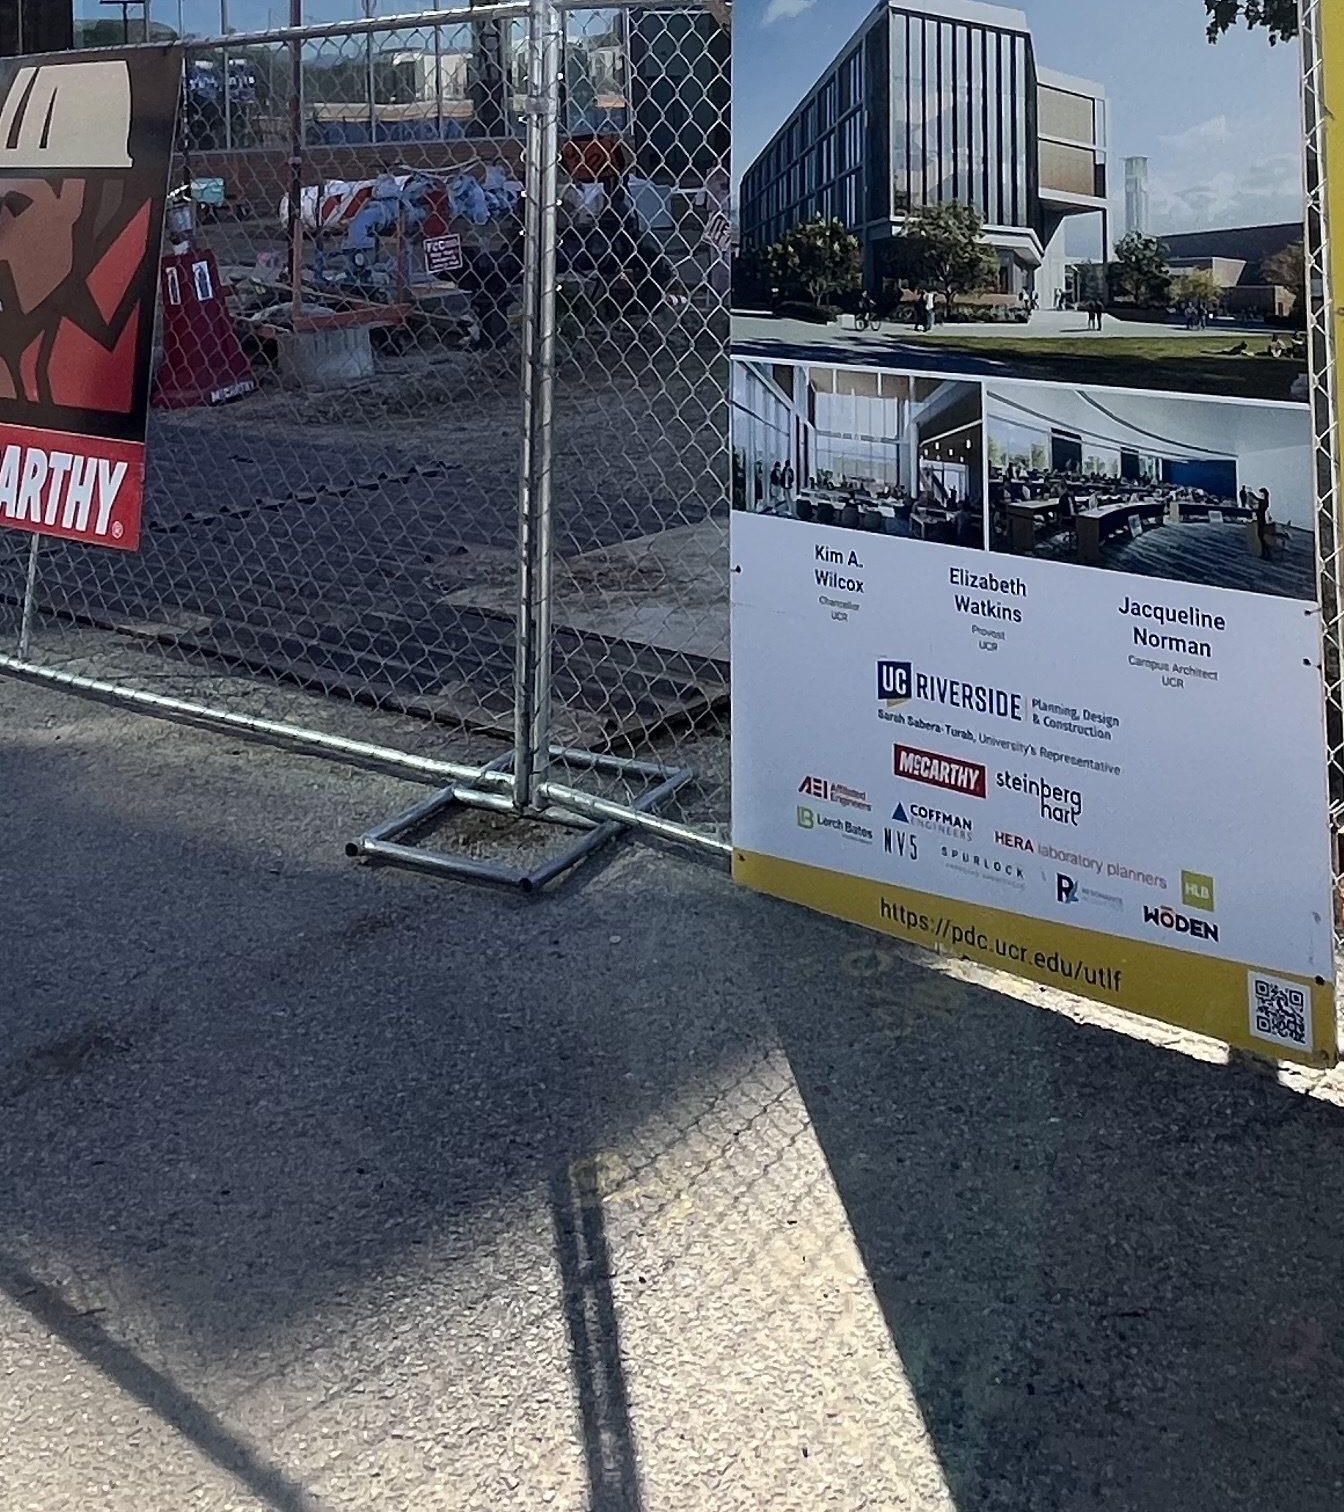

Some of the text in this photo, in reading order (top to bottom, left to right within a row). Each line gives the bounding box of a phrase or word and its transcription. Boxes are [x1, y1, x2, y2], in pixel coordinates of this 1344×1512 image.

[814, 544, 864, 569] Kim A.
[814, 569, 865, 594] Wilcox
[949, 566, 1027, 597] Elizabeth
[831, 611, 848, 622] UCR
[955, 594, 1022, 623] Watkins
[1118, 596, 1226, 631] Jacqueline
[971, 624, 1006, 641] Provost
[1133, 626, 1212, 658] Norman
[978, 641, 998, 652] UCR
[1128, 654, 1218, 681] Campus Architect
[882, 664, 1022, 721] UC RIVERSIDE
[1161, 675, 1184, 689] UCR
[1032, 713, 1112, 740] & Construction
[1083, 709, 1120, 727] Design
[878, 708, 906, 725] Sarah
[1040, 747, 1121, 776] Representative
[996, 770, 1082, 814] steinberg
[910, 804, 972, 831] COFFMAN
[1040, 799, 1081, 826] hart
[941, 845, 1025, 879] SPURLOCK
[994, 830, 1168, 889] HERA laboratory planners
[880, 896, 1123, 992] https://pdc.ucr.edu/utlf
